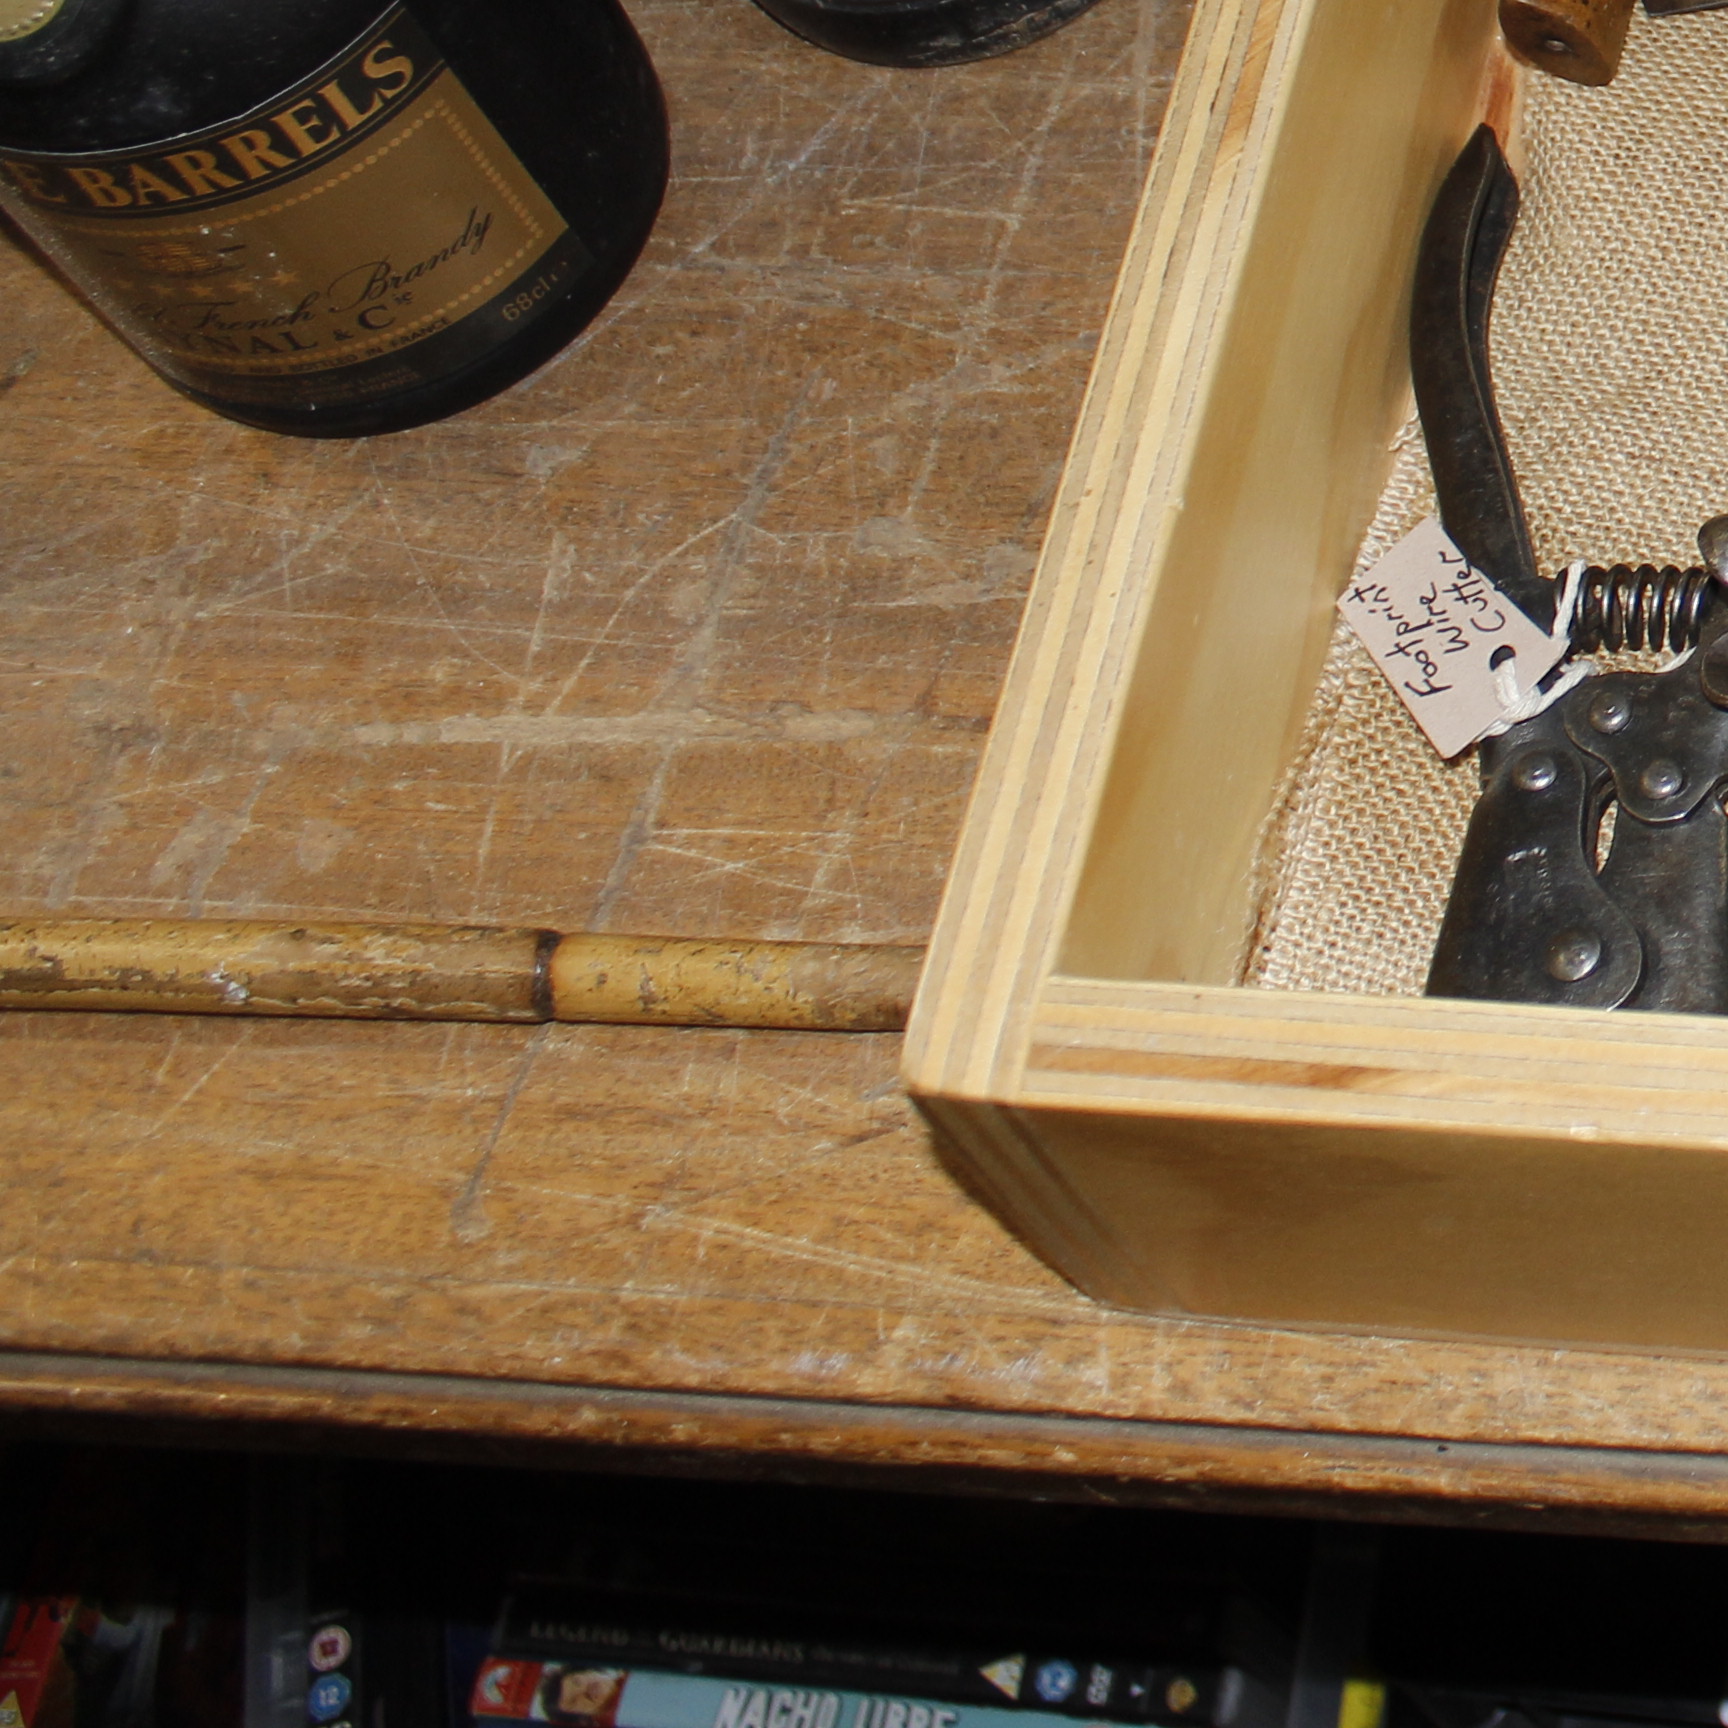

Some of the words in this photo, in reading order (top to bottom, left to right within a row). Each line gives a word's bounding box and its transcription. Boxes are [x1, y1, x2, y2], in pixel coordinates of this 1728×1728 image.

[68, 40, 415, 208] BARRELS
[320, 205, 494, 309] Brandy
[1419, 582, 1470, 654] Wire
[1438, 550, 1506, 632] Cutter
[714, 1688, 839, 1728] NACHO
